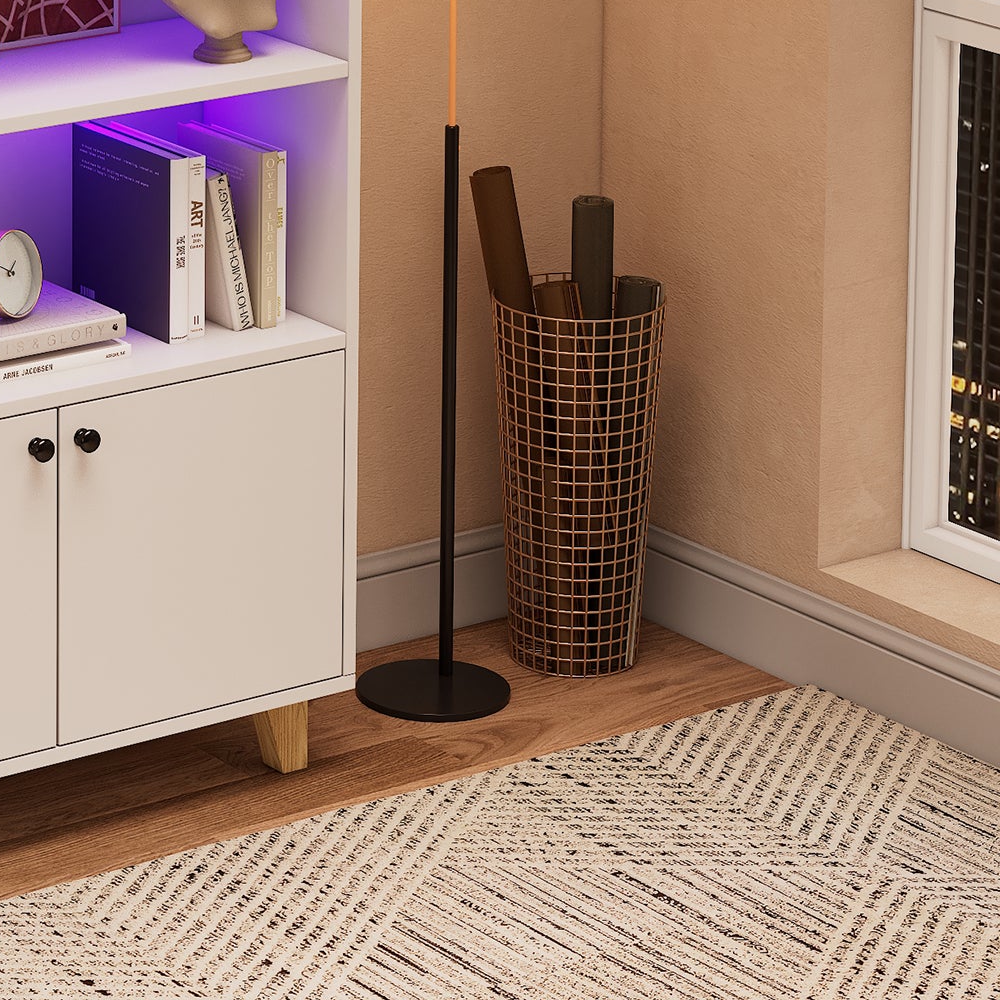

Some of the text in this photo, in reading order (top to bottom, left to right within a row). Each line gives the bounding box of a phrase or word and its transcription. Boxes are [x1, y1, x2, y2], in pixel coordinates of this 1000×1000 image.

[190, 200, 204, 229] ART
[218, 188, 250, 329] WHO IS MICHAEL JANG?
[32, 337, 40, 349] &
[47, 324, 106, 347] GLORY
[2, 363, 54, 381] ARNE JACOBSEN
